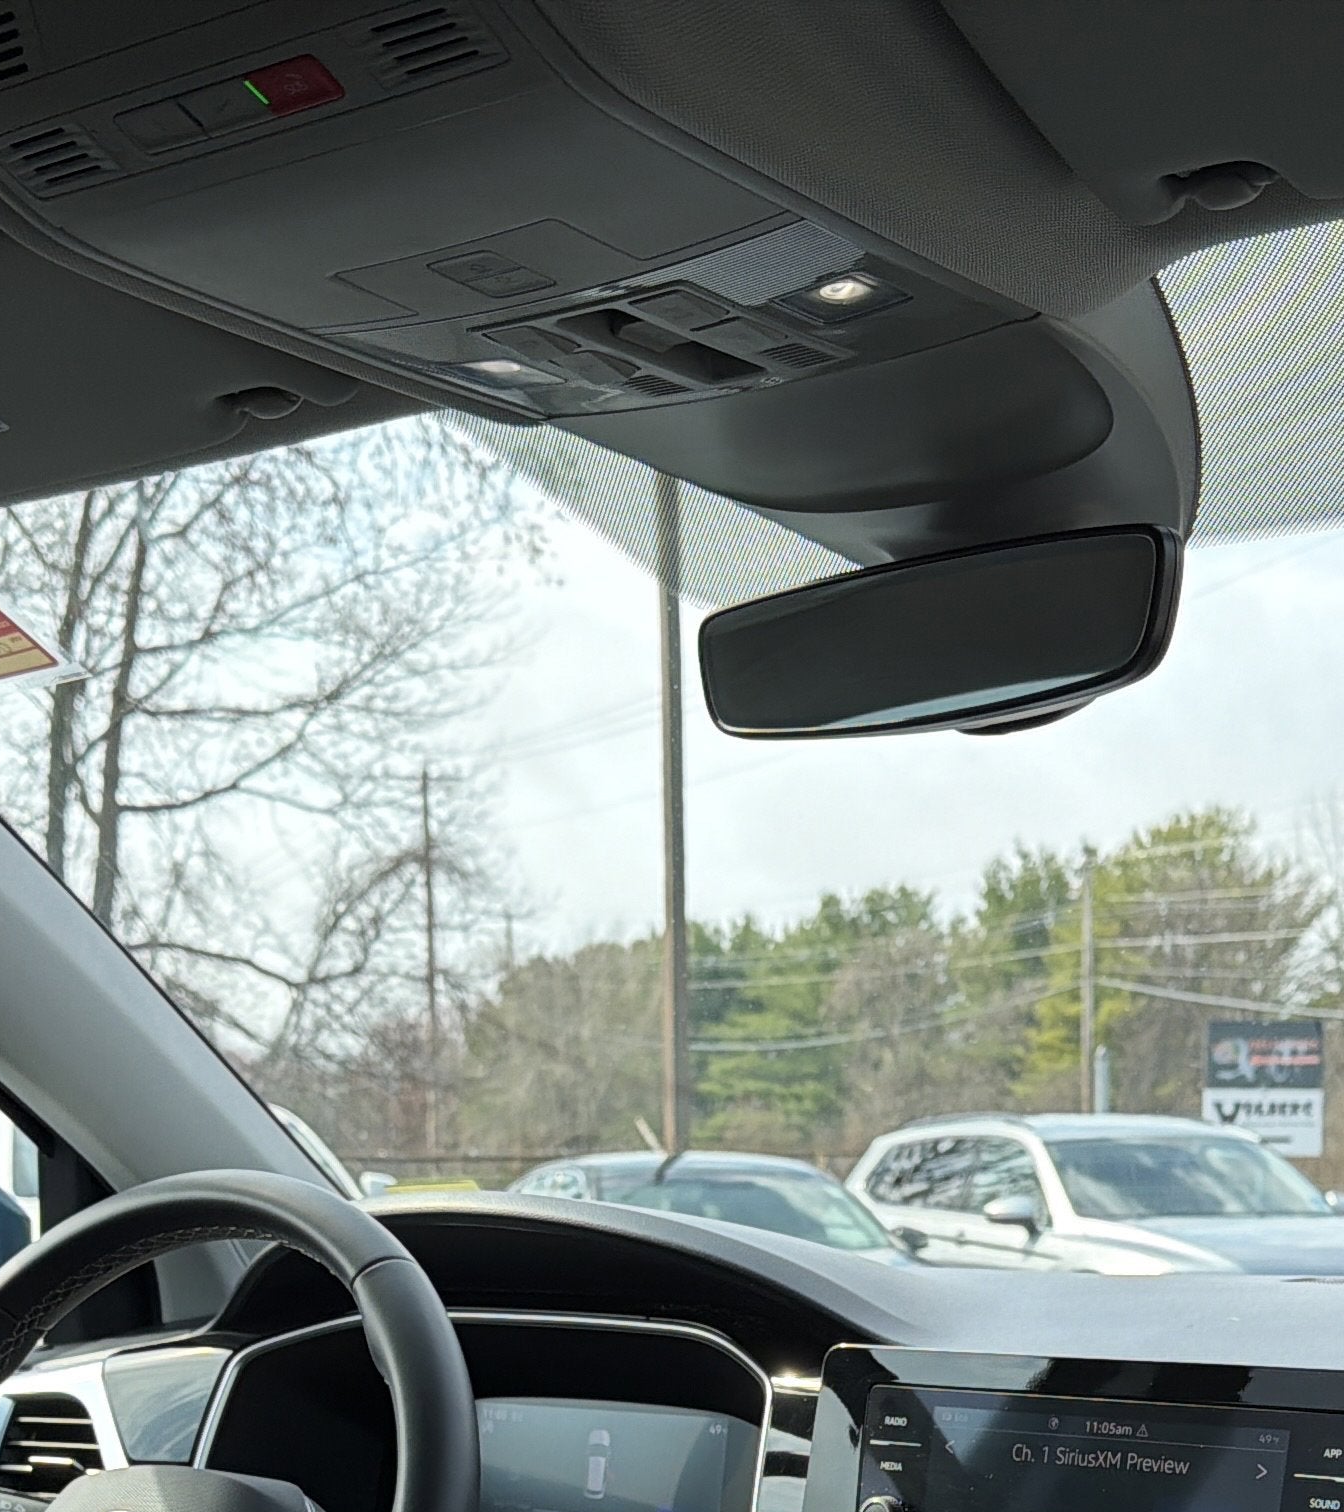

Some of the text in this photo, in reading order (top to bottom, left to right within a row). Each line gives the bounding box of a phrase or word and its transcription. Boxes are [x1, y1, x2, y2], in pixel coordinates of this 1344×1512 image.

[884, 1416, 908, 1427] RADIO
[1085, 1420, 1133, 1436] 11:05am
[1012, 1443, 1191, 1475] Ch. 1 SiriusXM Preview
[1323, 1448, 1343, 1460] APP
[879, 1461, 903, 1472] MEDIA
[1309, 1498, 1341, 1511] SOUND
